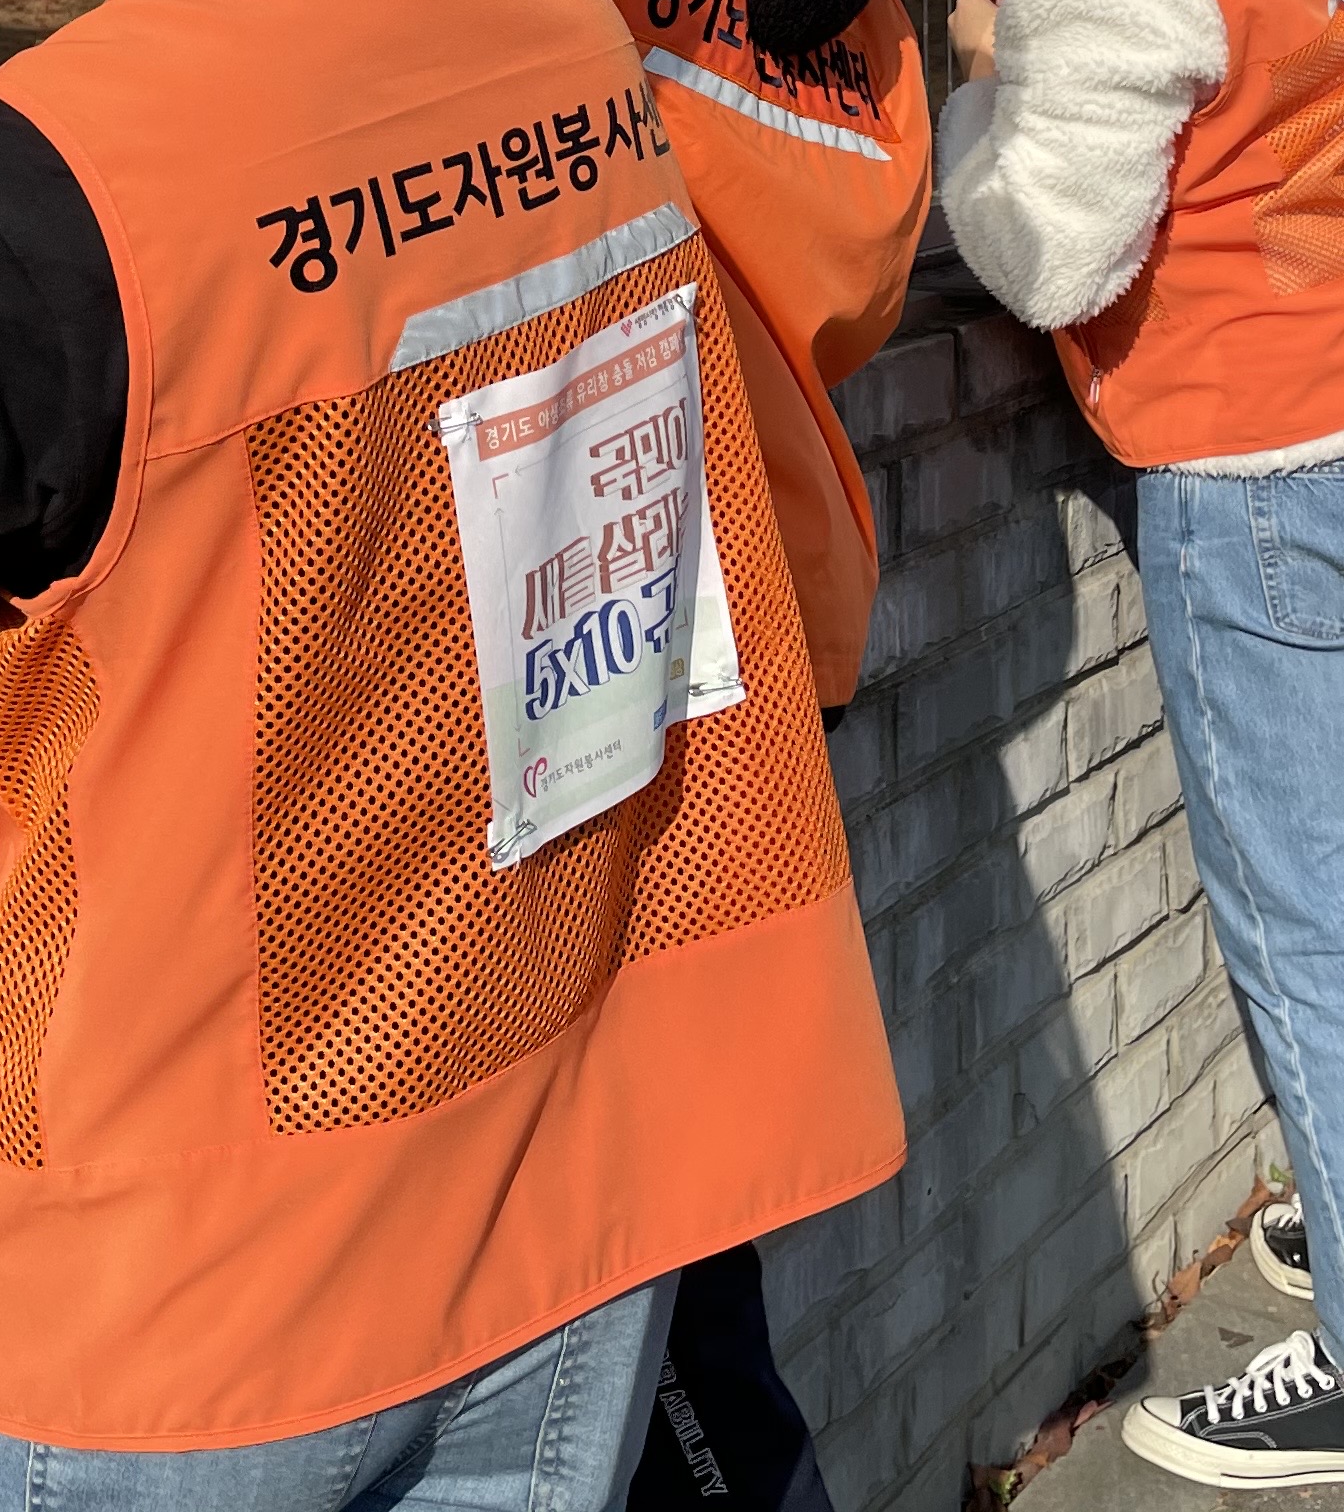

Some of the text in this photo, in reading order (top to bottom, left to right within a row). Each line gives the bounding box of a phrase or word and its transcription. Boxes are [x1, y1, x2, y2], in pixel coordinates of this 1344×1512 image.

[484, 414, 535, 451] 경기도
[576, 369, 609, 405] 유리창
[612, 357, 634, 386] 충돌
[635, 344, 658, 372] 저감
[521, 536, 596, 640] 새를
[525, 567, 680, 721] 5x10 규
[539, 738, 623, 793] 경기도자원봉사센터
[659, 1389, 729, 1497] ABILITY
